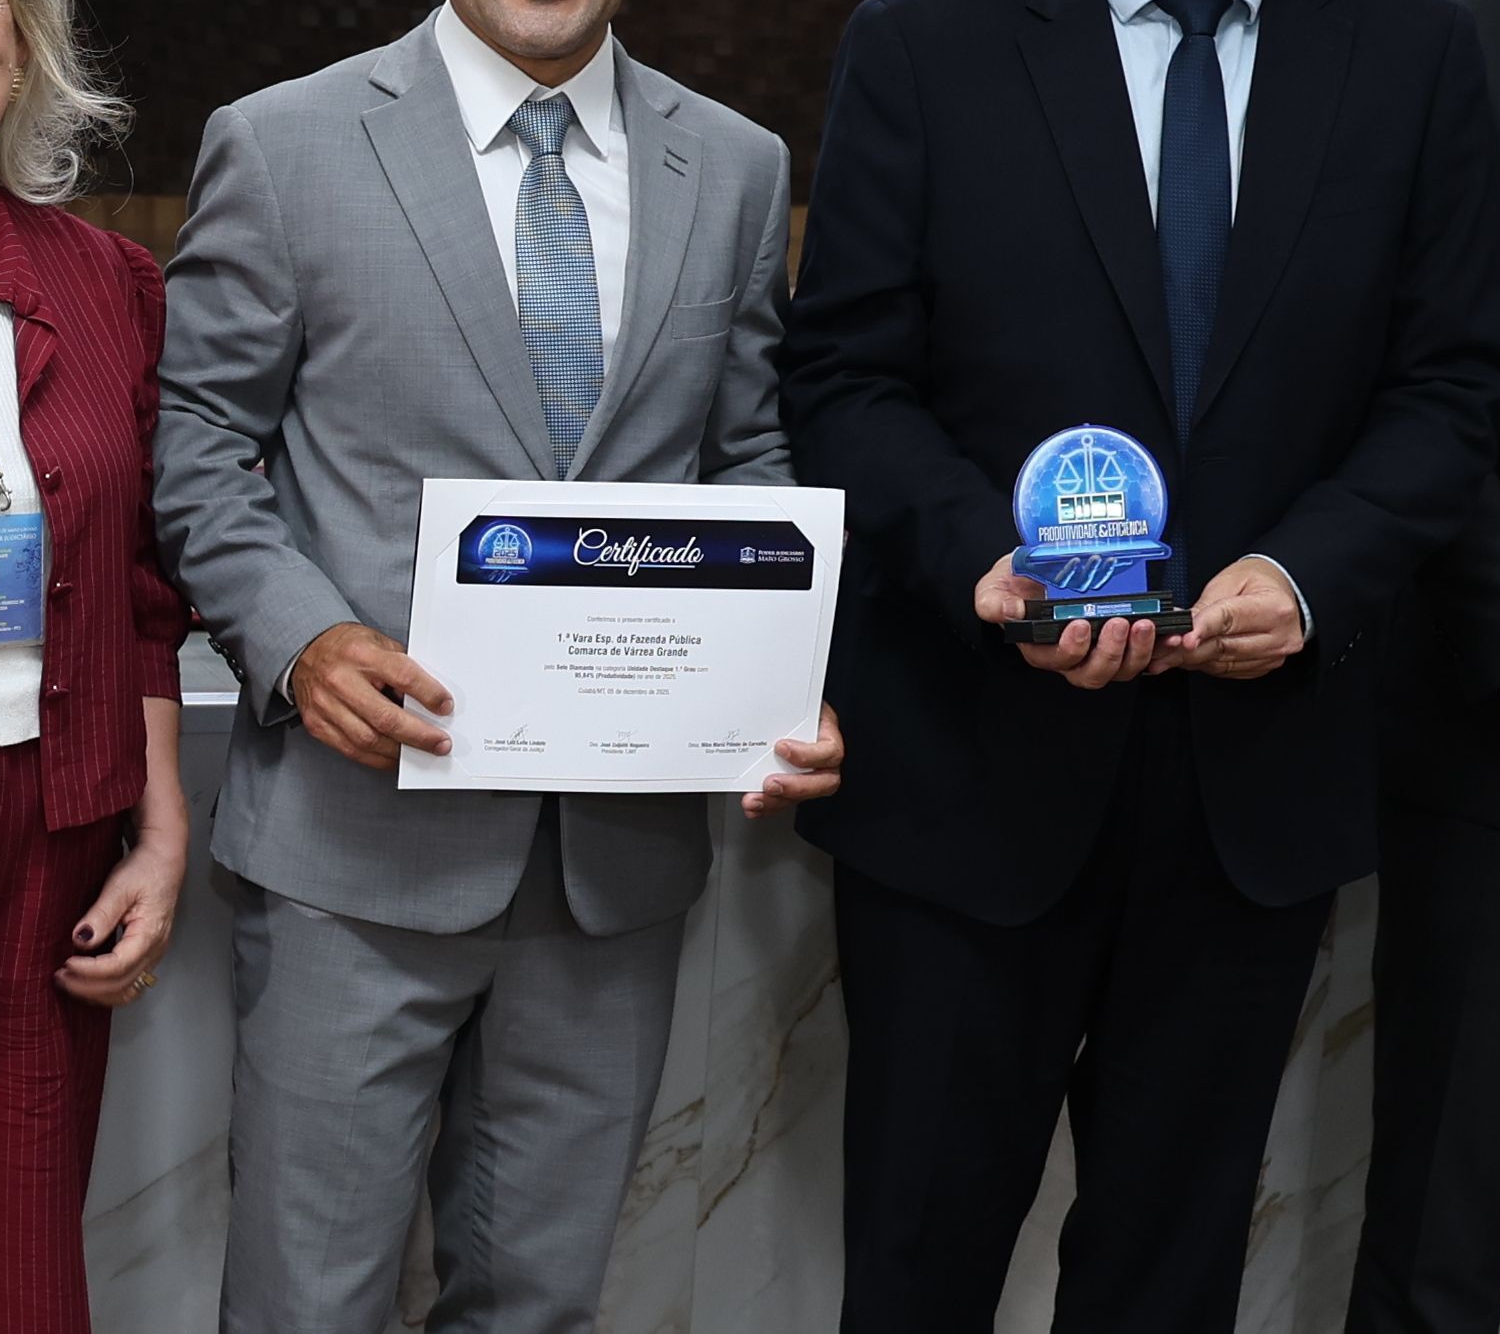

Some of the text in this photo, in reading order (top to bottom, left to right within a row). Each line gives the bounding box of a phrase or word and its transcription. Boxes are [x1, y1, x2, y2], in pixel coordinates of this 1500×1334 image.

[1038, 519, 1148, 542] PRODUTIVIDADE & EFICIÊNCIA
[573, 527, 704, 576] Certificado
[573, 633, 592, 643] Vara
[596, 633, 614, 645] Esp.
[617, 634, 627, 643] da
[630, 634, 666, 644] Fazenda
[669, 635, 701, 644] Pública
[568, 646, 688, 657] Comarca de Várzea Grande
